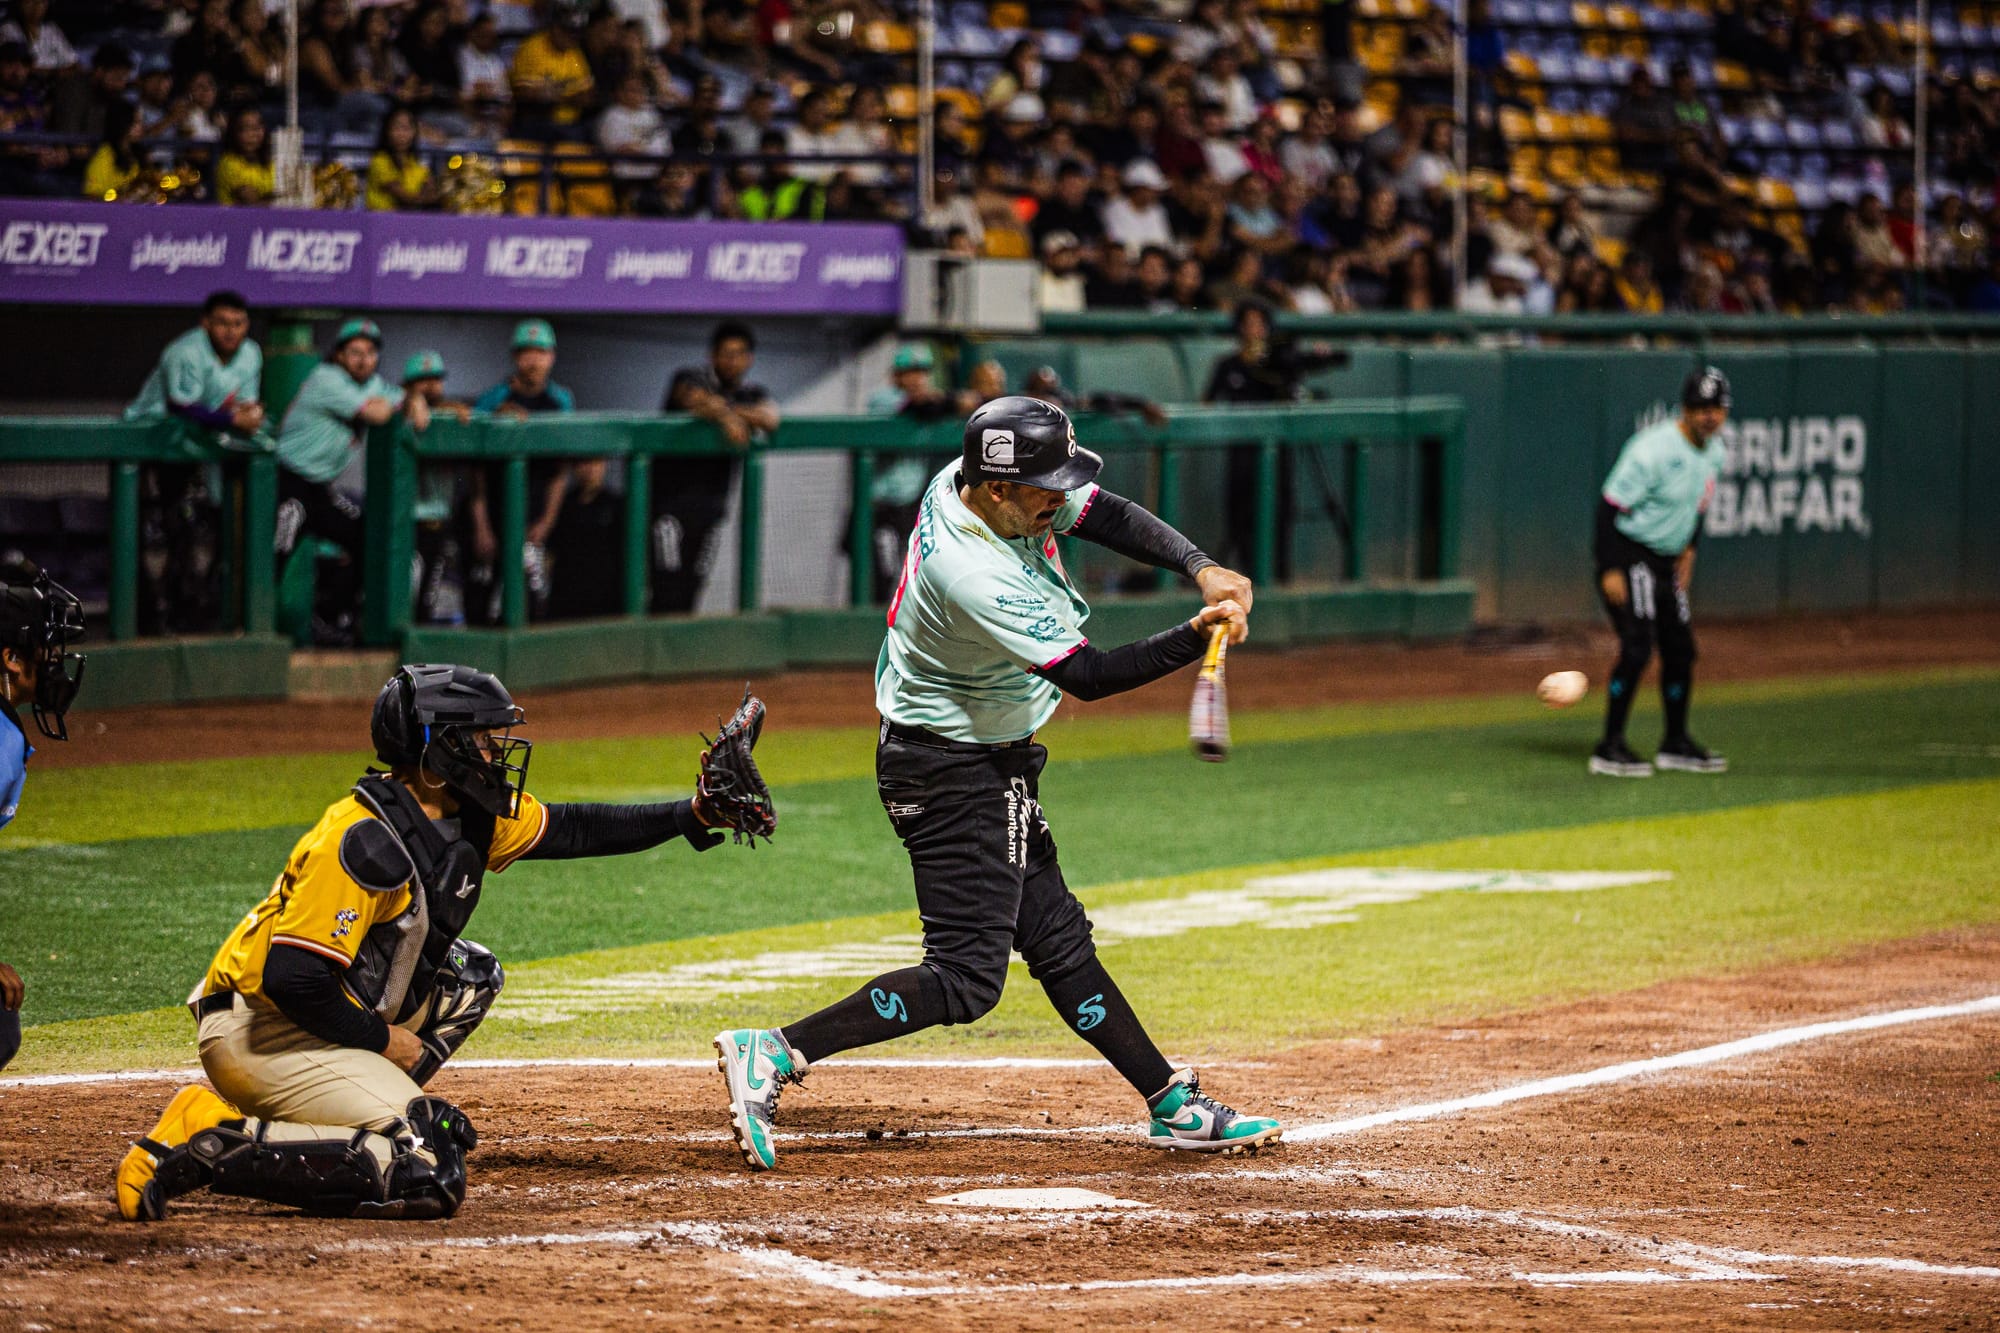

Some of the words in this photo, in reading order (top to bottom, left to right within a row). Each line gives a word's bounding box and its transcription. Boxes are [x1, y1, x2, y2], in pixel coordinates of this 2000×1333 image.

[247, 228, 362, 273] MEXBET
[980, 464, 1020, 474] caliente.mx
[1027, 615, 1057, 637] RCG
